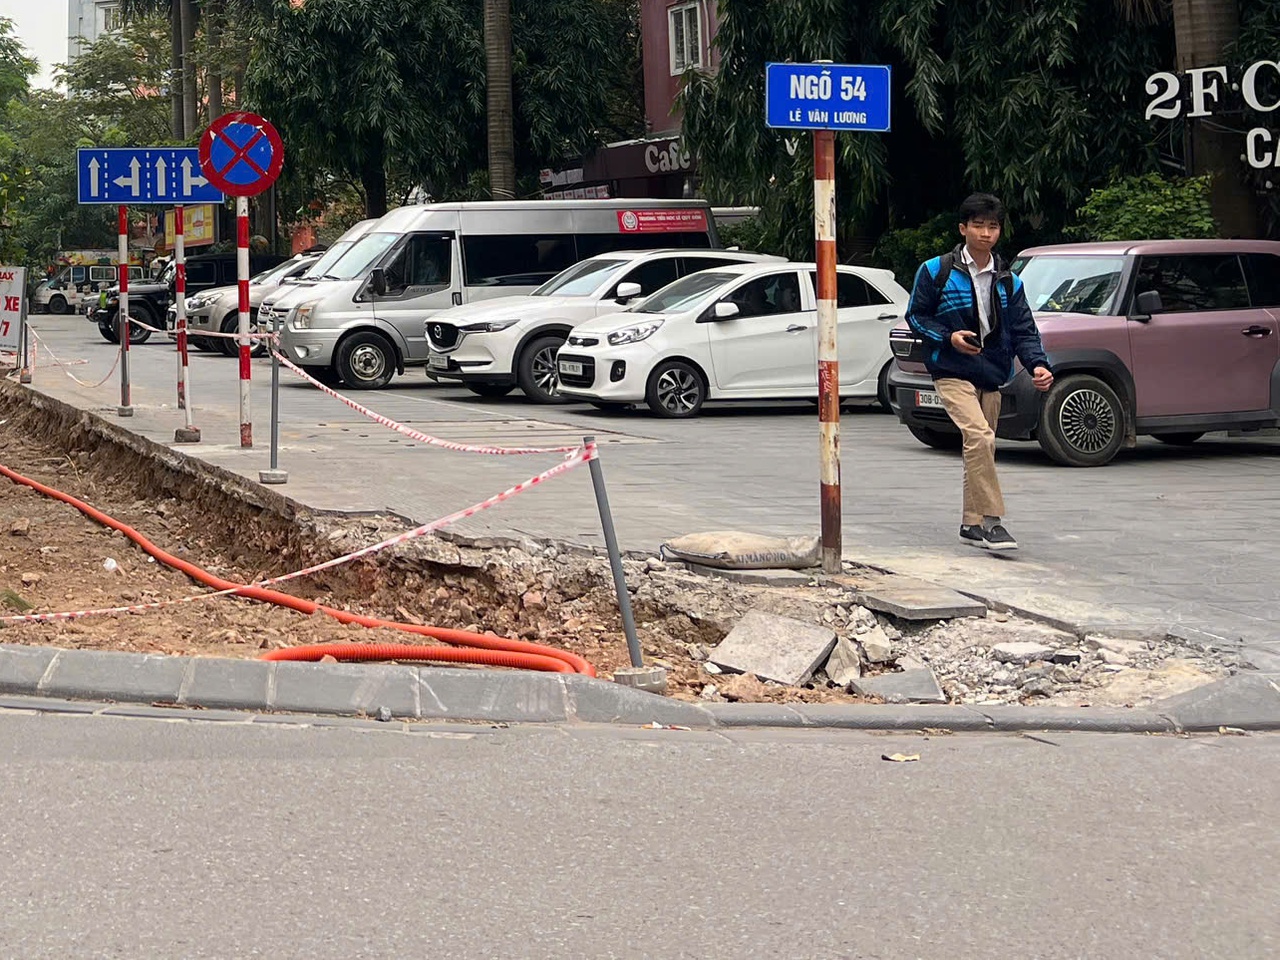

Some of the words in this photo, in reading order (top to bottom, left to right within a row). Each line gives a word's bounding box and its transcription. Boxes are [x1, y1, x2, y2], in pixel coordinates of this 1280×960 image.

[790, 70, 832, 100] NGÕ
[840, 76, 867, 101] 54
[789, 108, 802, 122] LÊ
[808, 108, 829, 123] VĂN
[834, 111, 867, 124] LƯƠNG
[4, 295, 20, 312] XE
